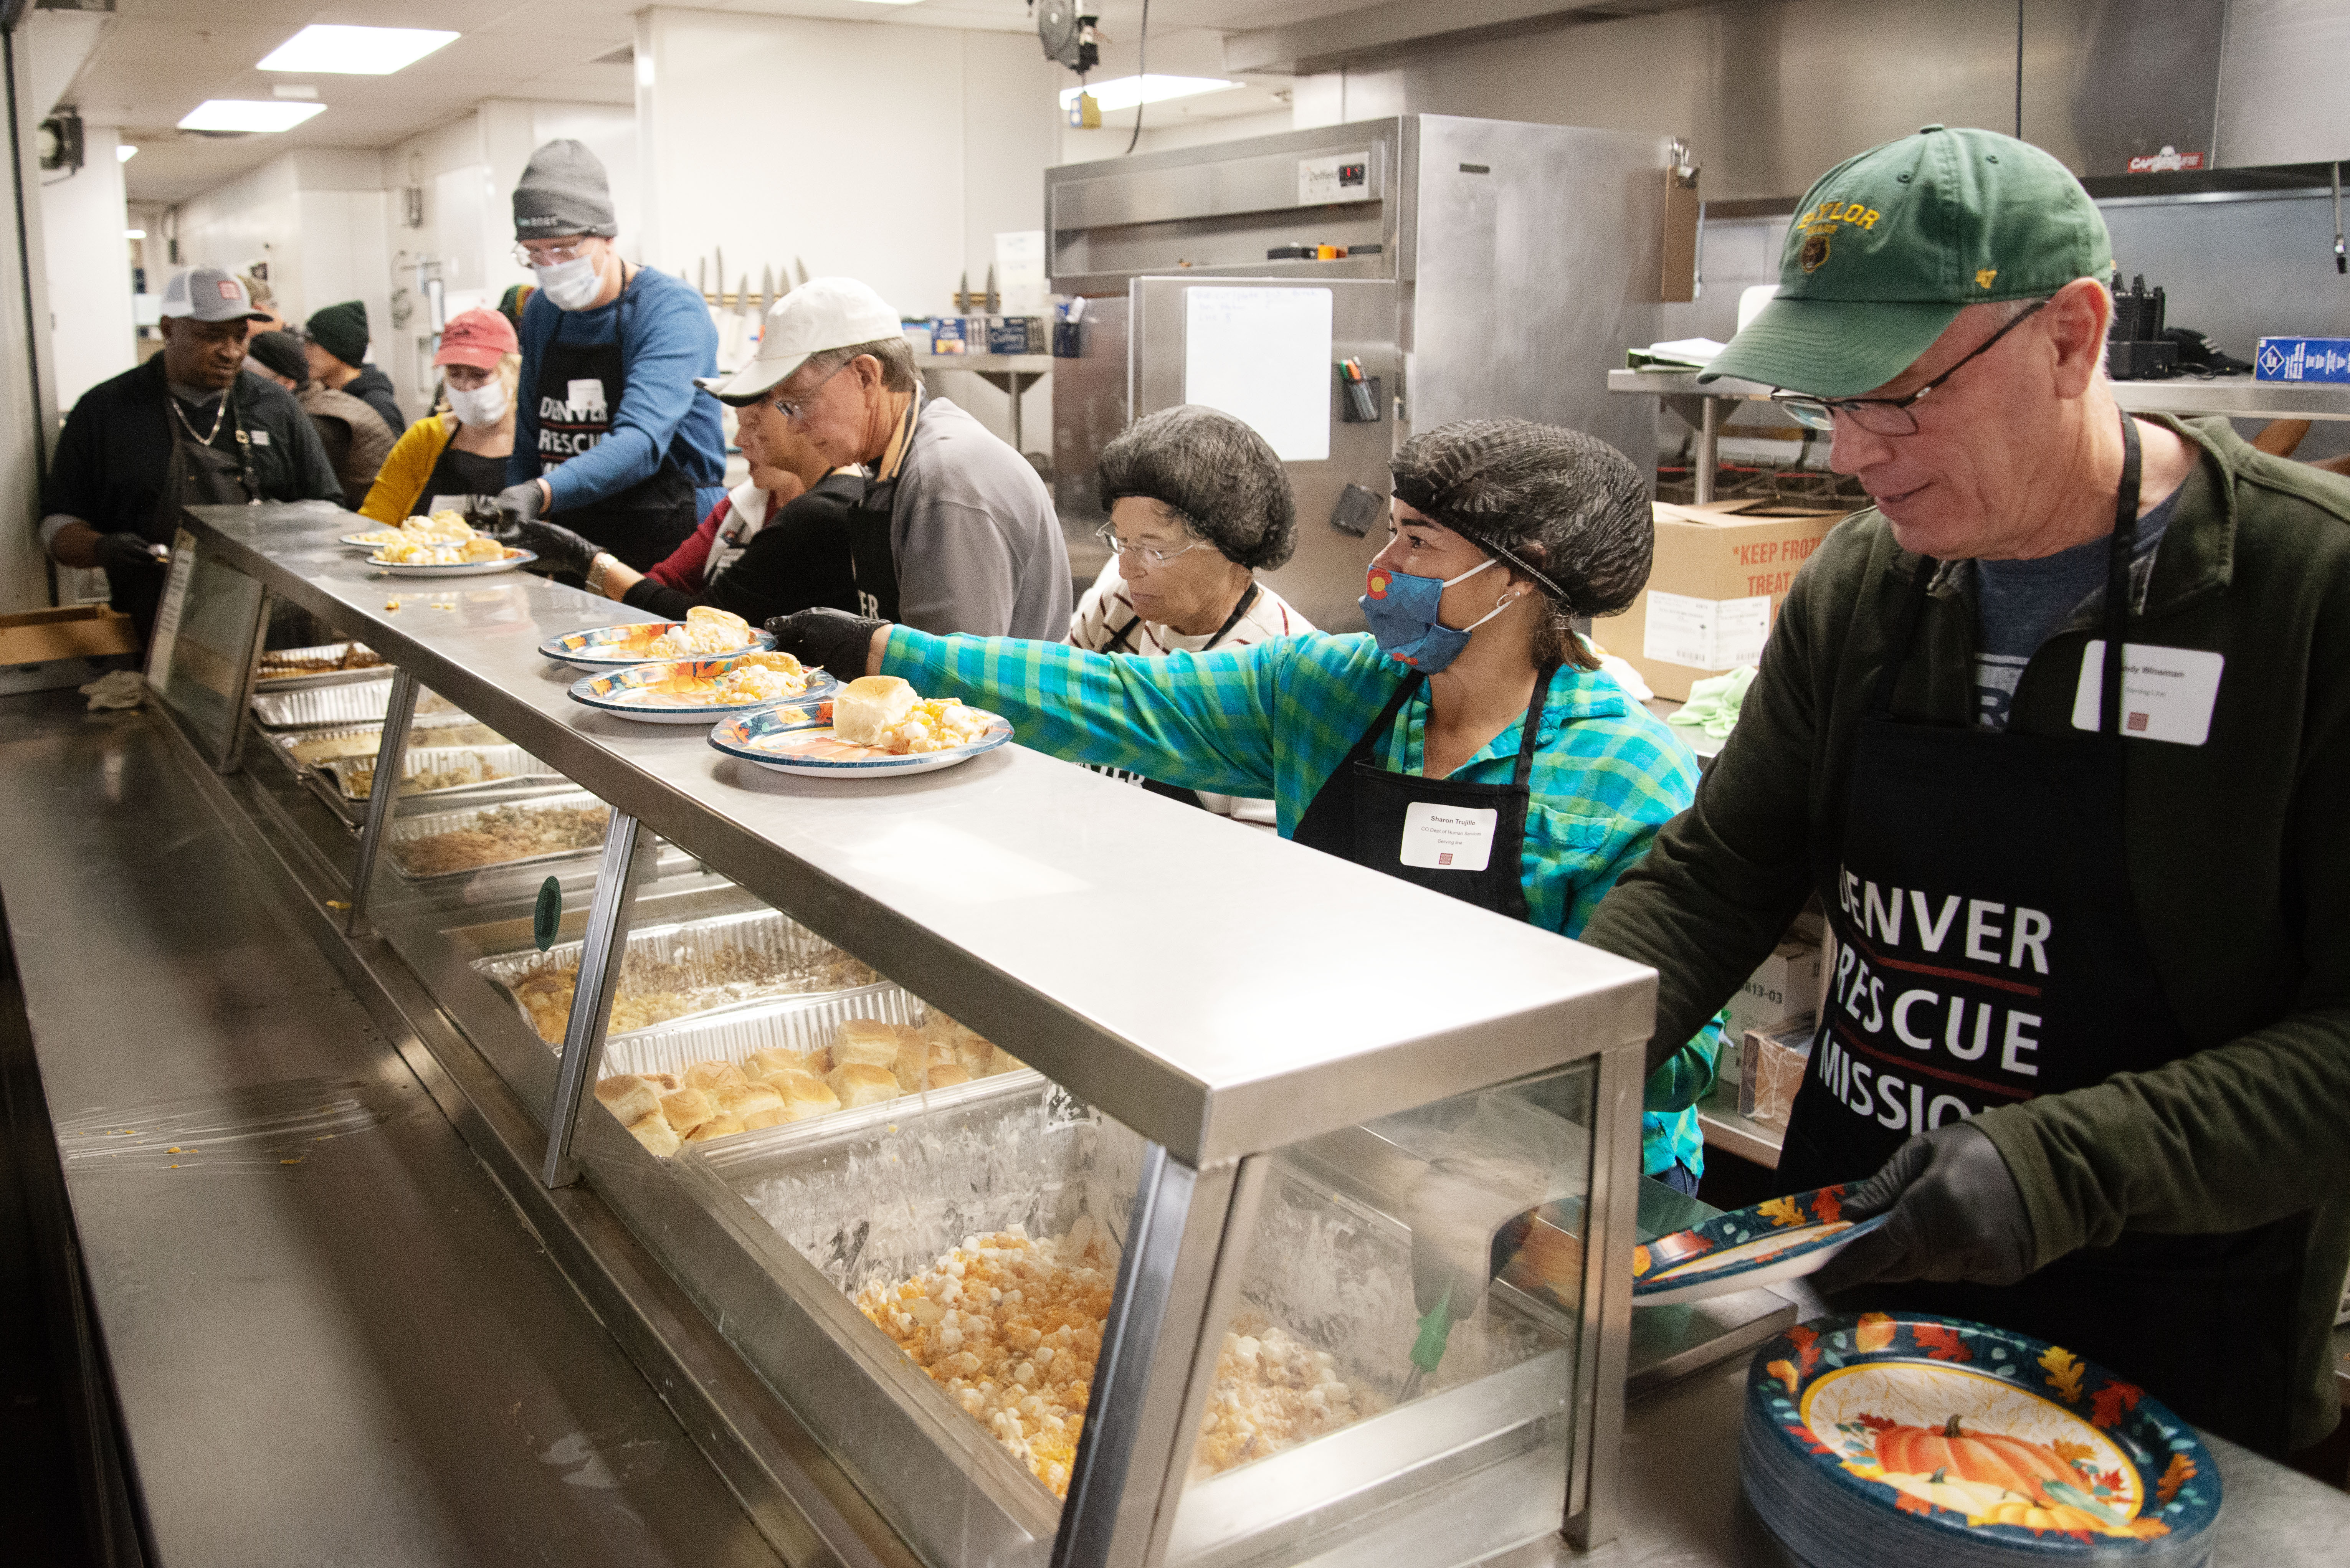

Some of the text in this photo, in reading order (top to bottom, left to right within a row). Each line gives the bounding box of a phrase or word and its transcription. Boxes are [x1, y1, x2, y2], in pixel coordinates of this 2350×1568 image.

[538, 428, 602, 455] RESCU
[1782, 537, 1822, 562] FROZ
[1748, 571, 1791, 596] TREAT
[1839, 863, 2052, 975] DENVER
[1741, 981, 1783, 1005] 813-03
[1837, 942, 2042, 1076] RESCUE
[1819, 1028, 1996, 1136] MISSIO
